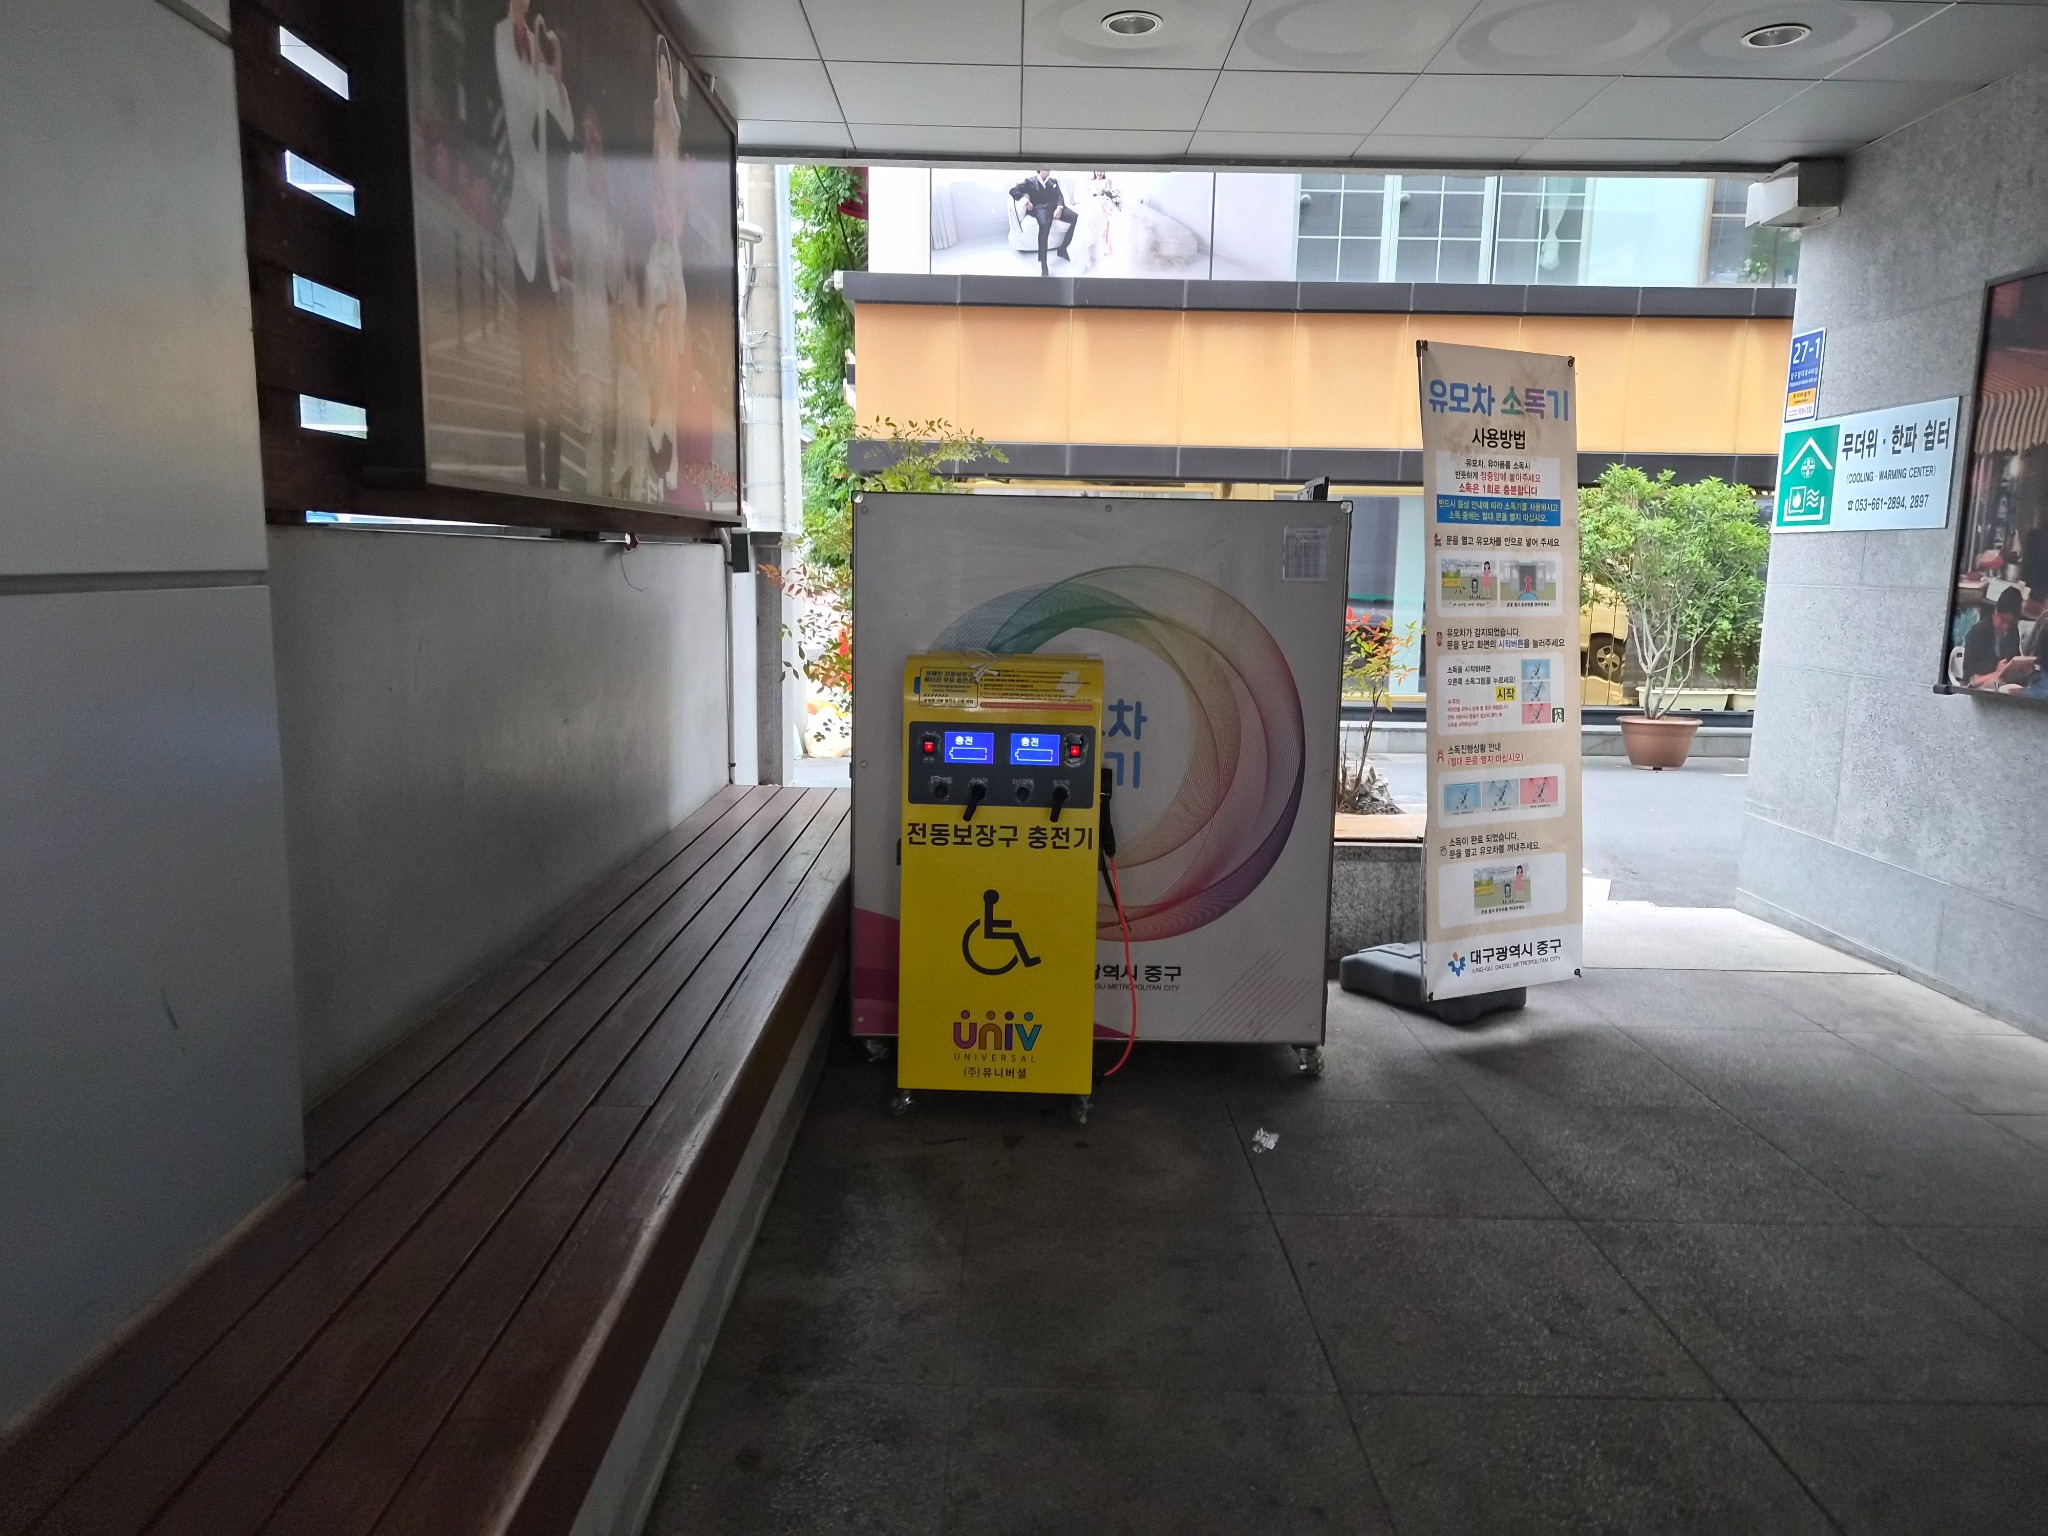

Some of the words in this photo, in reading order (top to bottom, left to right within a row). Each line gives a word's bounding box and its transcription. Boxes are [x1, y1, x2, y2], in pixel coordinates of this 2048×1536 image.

[1793, 338, 1820, 365] 27-1
[1428, 379, 1495, 417] 유모차
[1500, 385, 1569, 421] 소독기
[1472, 428, 1526, 450] 사용방법
[1841, 428, 1878, 461] 무더위
[1891, 424, 1917, 455] 한파
[1923, 418, 1951, 451] 쉼터
[1465, 458, 1486, 469] 유모차,
[1513, 461, 1531, 471] 소독시
[1847, 473, 1874, 484] (COOLING
[1878, 468, 1907, 480] WARMING
[1909, 466, 1936, 478] CENTER)
[1458, 482, 1479, 494] 소독은
[1482, 484, 1501, 495] 1회로
[1503, 485, 1538, 496] 충분합니다
[1854, 496, 1907, 512] 053-661-2894,
[1909, 494, 1929, 509] 2897
[1446, 535, 1459, 545] 문을
[1461, 536, 1474, 545] 열고
[1476, 536, 1502, 547] 유모차를
[1503, 537, 1523, 547] 안으로
[1540, 538, 1560, 548] 주세요
[1446, 628, 1472, 638] 유모차가
[1446, 640, 1459, 650] 문을
[1498, 638, 1530, 649] 시작버튼을
[1532, 638, 1566, 649] 눌러주세요
[1496, 688, 1515, 700] 시작
[955, 735, 973, 746] 충전
[1021, 737, 1039, 747] 충전
[1488, 742, 1501, 752] 안내
[1465, 755, 1478, 766] 문을
[906, 822, 1019, 848] 전동보장구
[1027, 826, 1094, 850] 충전기
[1449, 838, 1469, 848] 소독이
[1471, 835, 1483, 845] 완료
[1449, 849, 1462, 860] 문을
[1464, 847, 1477, 857] 열고
[1479, 845, 1504, 857] 유모차를
[1470, 942, 1532, 965] 대구광역시
[1536, 939, 1561, 956] 중구
[1145, 965, 1182, 983] 중구
[953, 1053, 1036, 1064] UNIVERSAL
